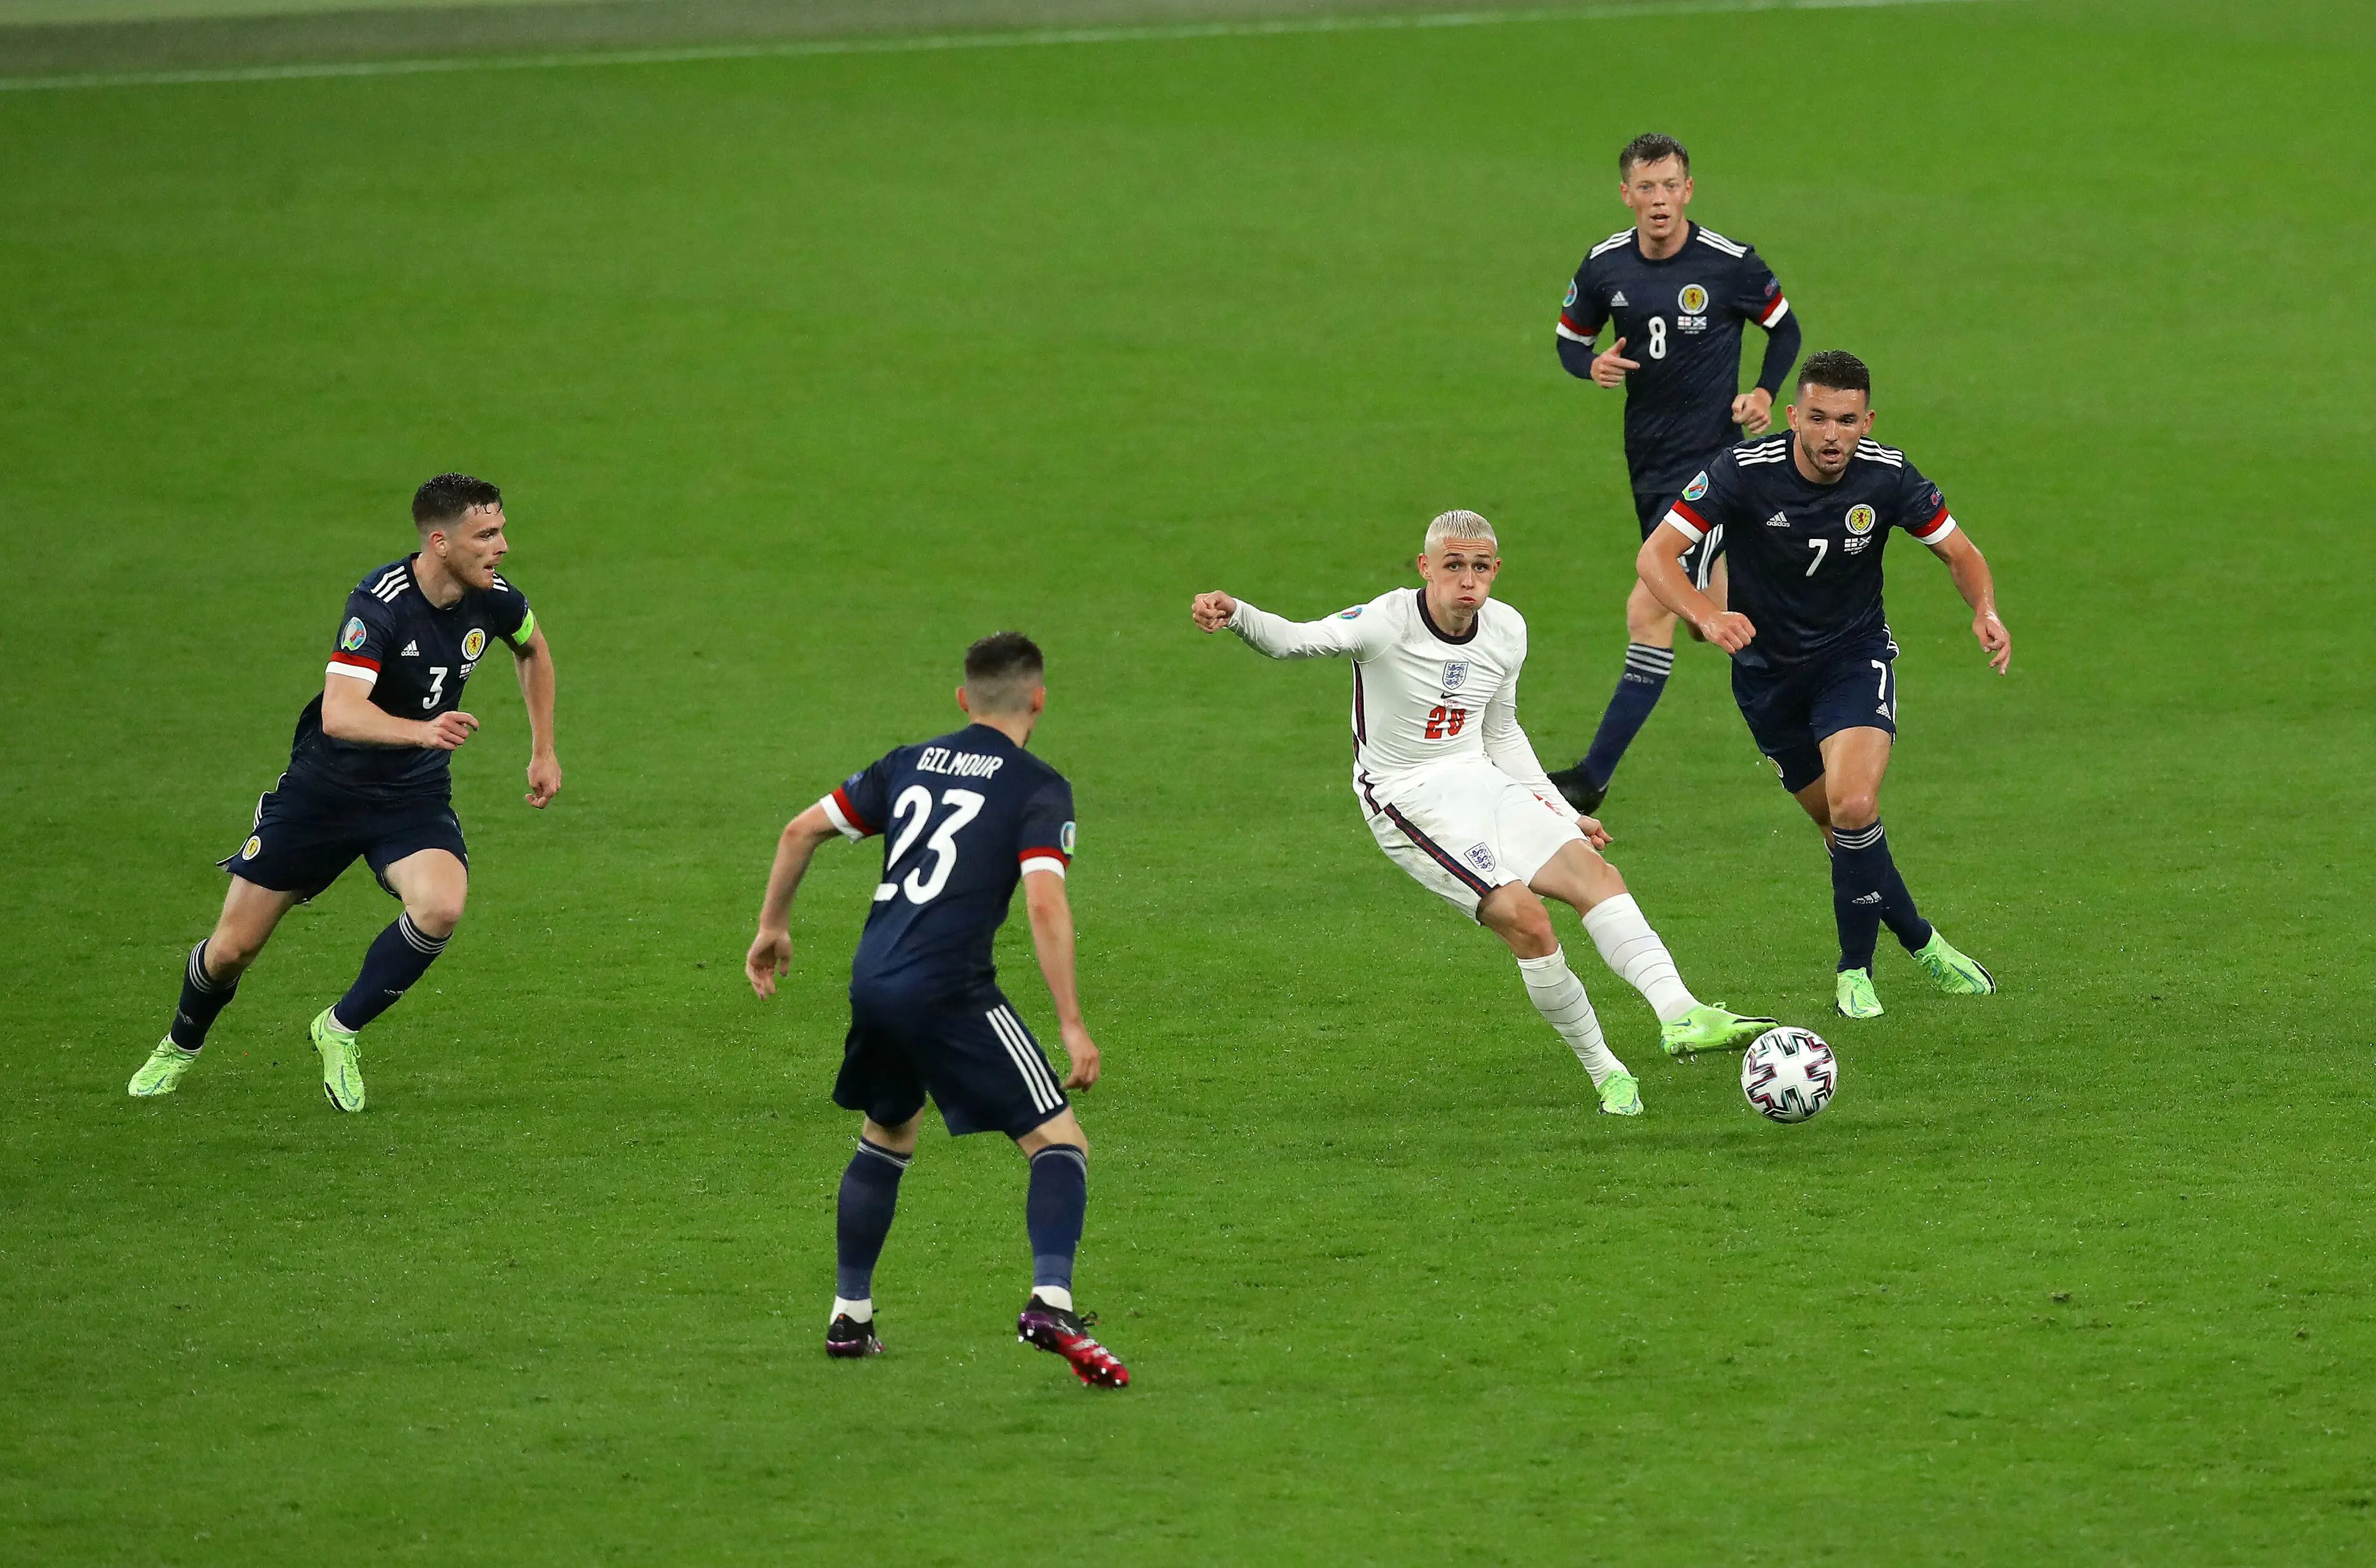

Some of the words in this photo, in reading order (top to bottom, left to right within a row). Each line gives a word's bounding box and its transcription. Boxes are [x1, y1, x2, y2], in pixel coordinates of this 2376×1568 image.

[1648, 316, 1667, 360] 8
[1806, 538, 1828, 577] 7
[423, 666, 448, 709] 3
[1870, 659, 1887, 700] 7
[916, 746, 1004, 780] GILMOUR
[874, 784, 986, 905] 23
